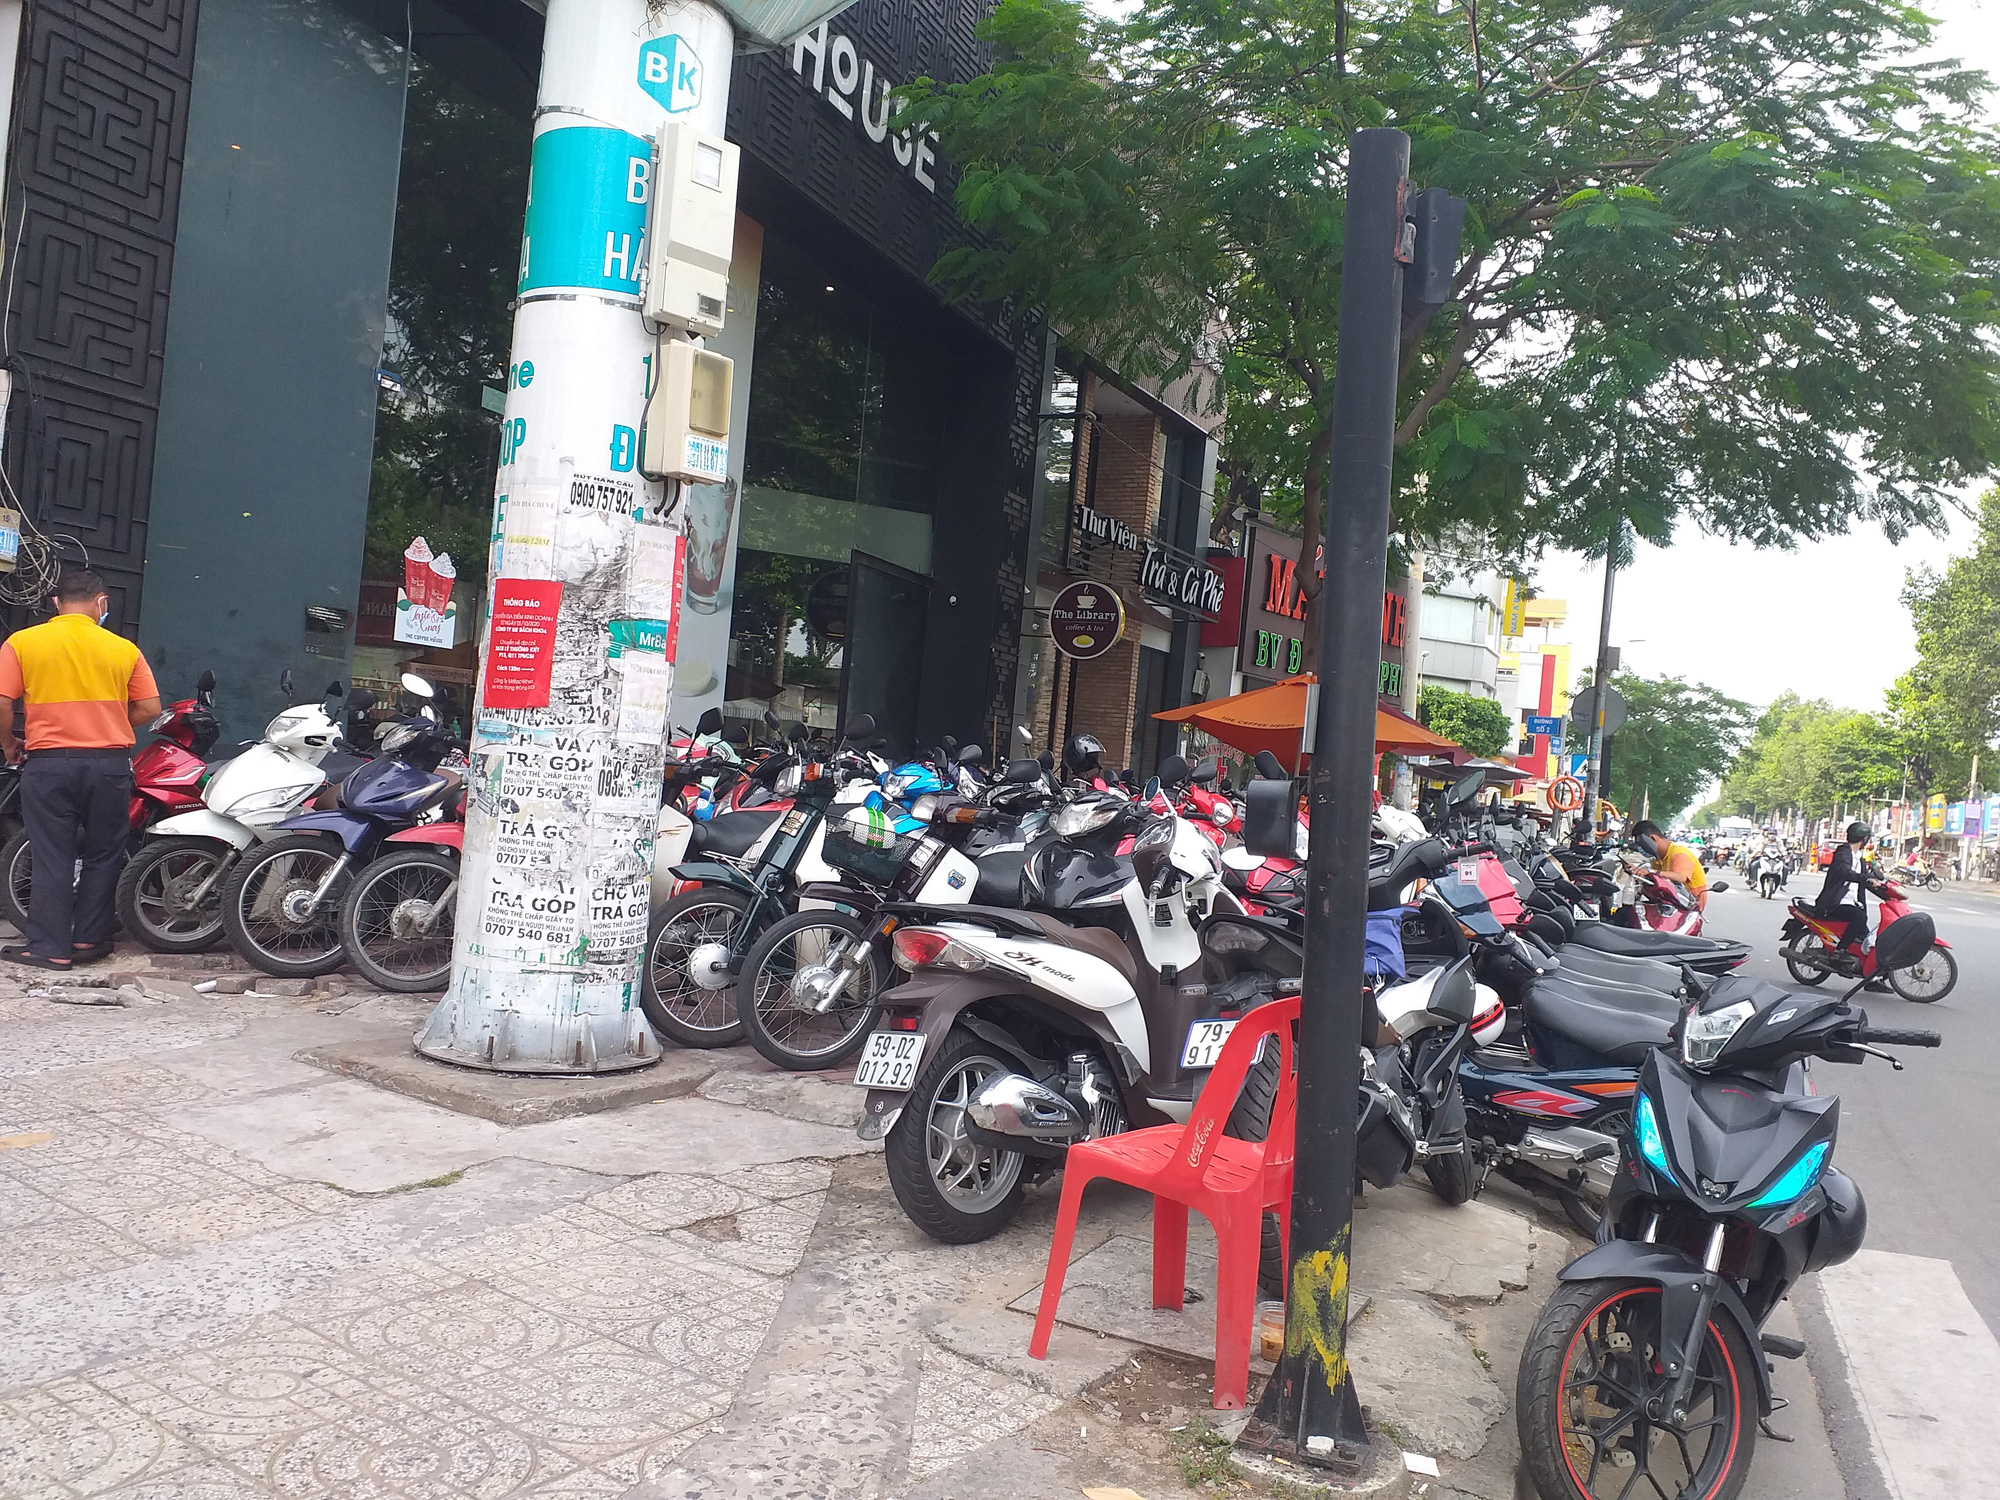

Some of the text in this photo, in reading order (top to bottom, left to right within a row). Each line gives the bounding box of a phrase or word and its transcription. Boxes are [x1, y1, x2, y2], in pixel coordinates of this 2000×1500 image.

[644, 49, 699, 98] BK
[508, 358, 535, 393] ne
[570, 481, 634, 516] 0909.757.921
[1081, 505, 1139, 552] Thư Viện
[1141, 540, 1168, 588] Trà
[1181, 565, 1201, 606] Cà
[1202, 569, 1226, 613] Phê
[503, 597, 540, 608] THÔNG BÁO
[1053, 609, 1117, 623] The Library
[1510, 613, 1519, 634] NAM
[1064, 624, 1085, 633] coffee
[1093, 625, 1106, 633] tea
[414, 634, 429, 642] COFFEE
[430, 636, 443, 644] HOUSE
[639, 631, 667, 650] MrBa
[1256, 629, 1283, 669] BV
[1536, 725, 1545, 733] SỐ
[550, 753, 594, 772] GÓP
[503, 785, 534, 798] 0707
[496, 852, 526, 866] 0707
[1073, 848, 1095, 858] HONDA
[632, 883, 650, 898] VAY
[488, 906, 509, 916] KHÔNG
[532, 894, 576, 914] GÓP
[591, 898, 648, 920] TRẢ GÓP
[485, 922, 572, 944] 0707 540 681
[619, 934, 635, 946] 540
[1042, 965, 1076, 982] mode
[1200, 1023, 1231, 1043] 79-
[872, 1036, 916, 1060] 59-D2
[858, 1060, 913, 1086] 012.92
